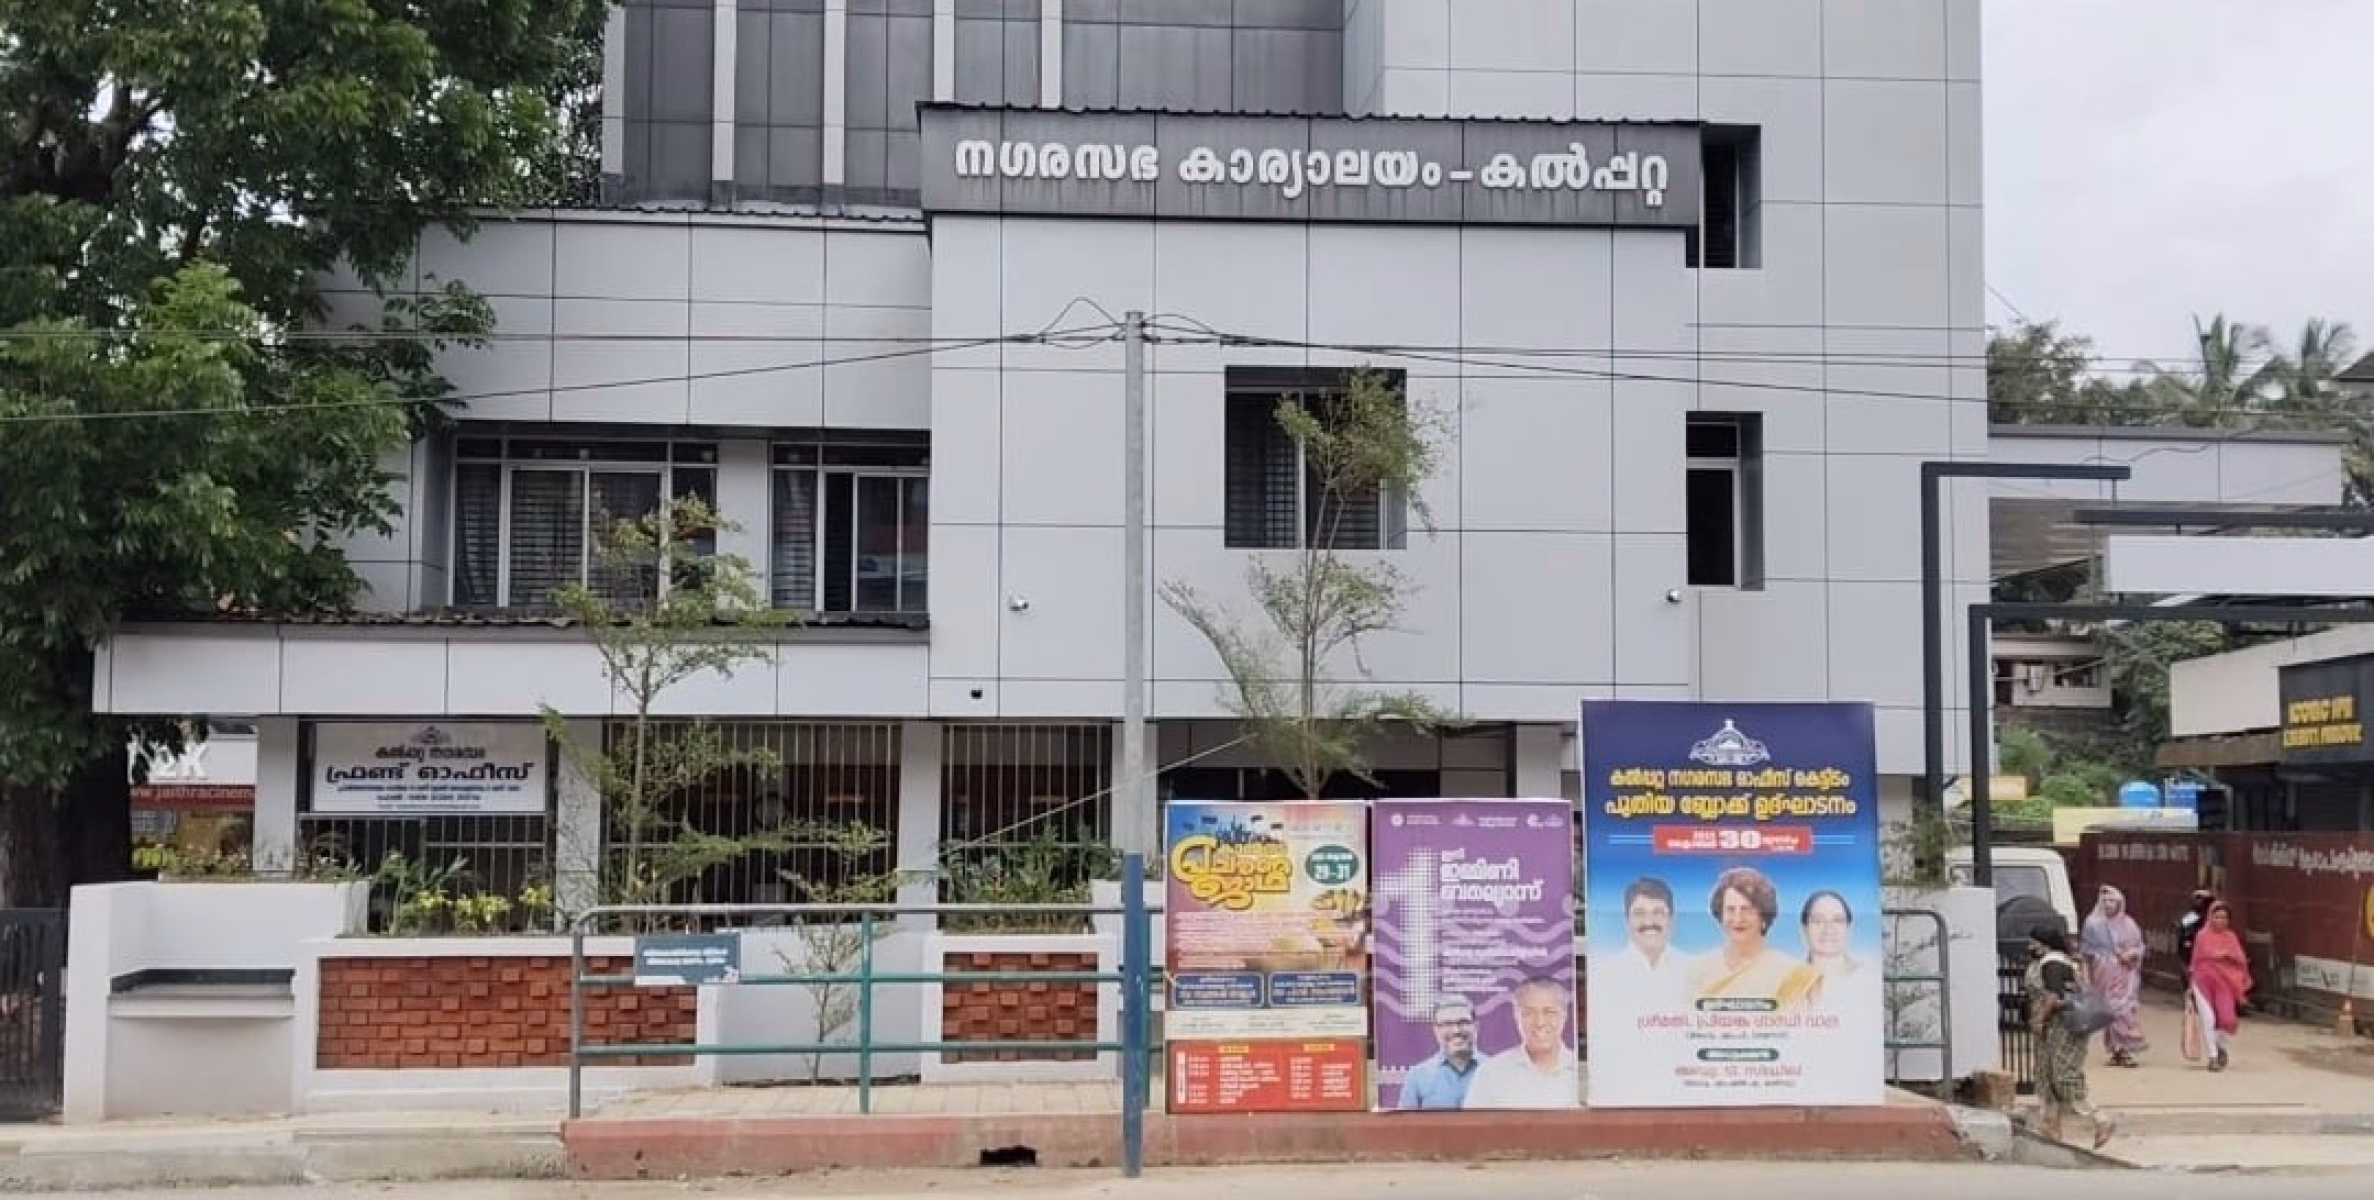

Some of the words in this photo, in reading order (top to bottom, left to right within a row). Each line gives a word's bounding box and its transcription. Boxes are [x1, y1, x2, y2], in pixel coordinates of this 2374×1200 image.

[955, 140, 1159, 181] നഗരസഭ
[326, 763, 411, 783] ഫ്രണ്ട്
[418, 763, 534, 780] ഓഫീസ്
[1605, 792, 1675, 818] പുതിയ
[1680, 792, 1752, 820] ബ്ലോക്ക്
[1718, 830, 1761, 849] 30
